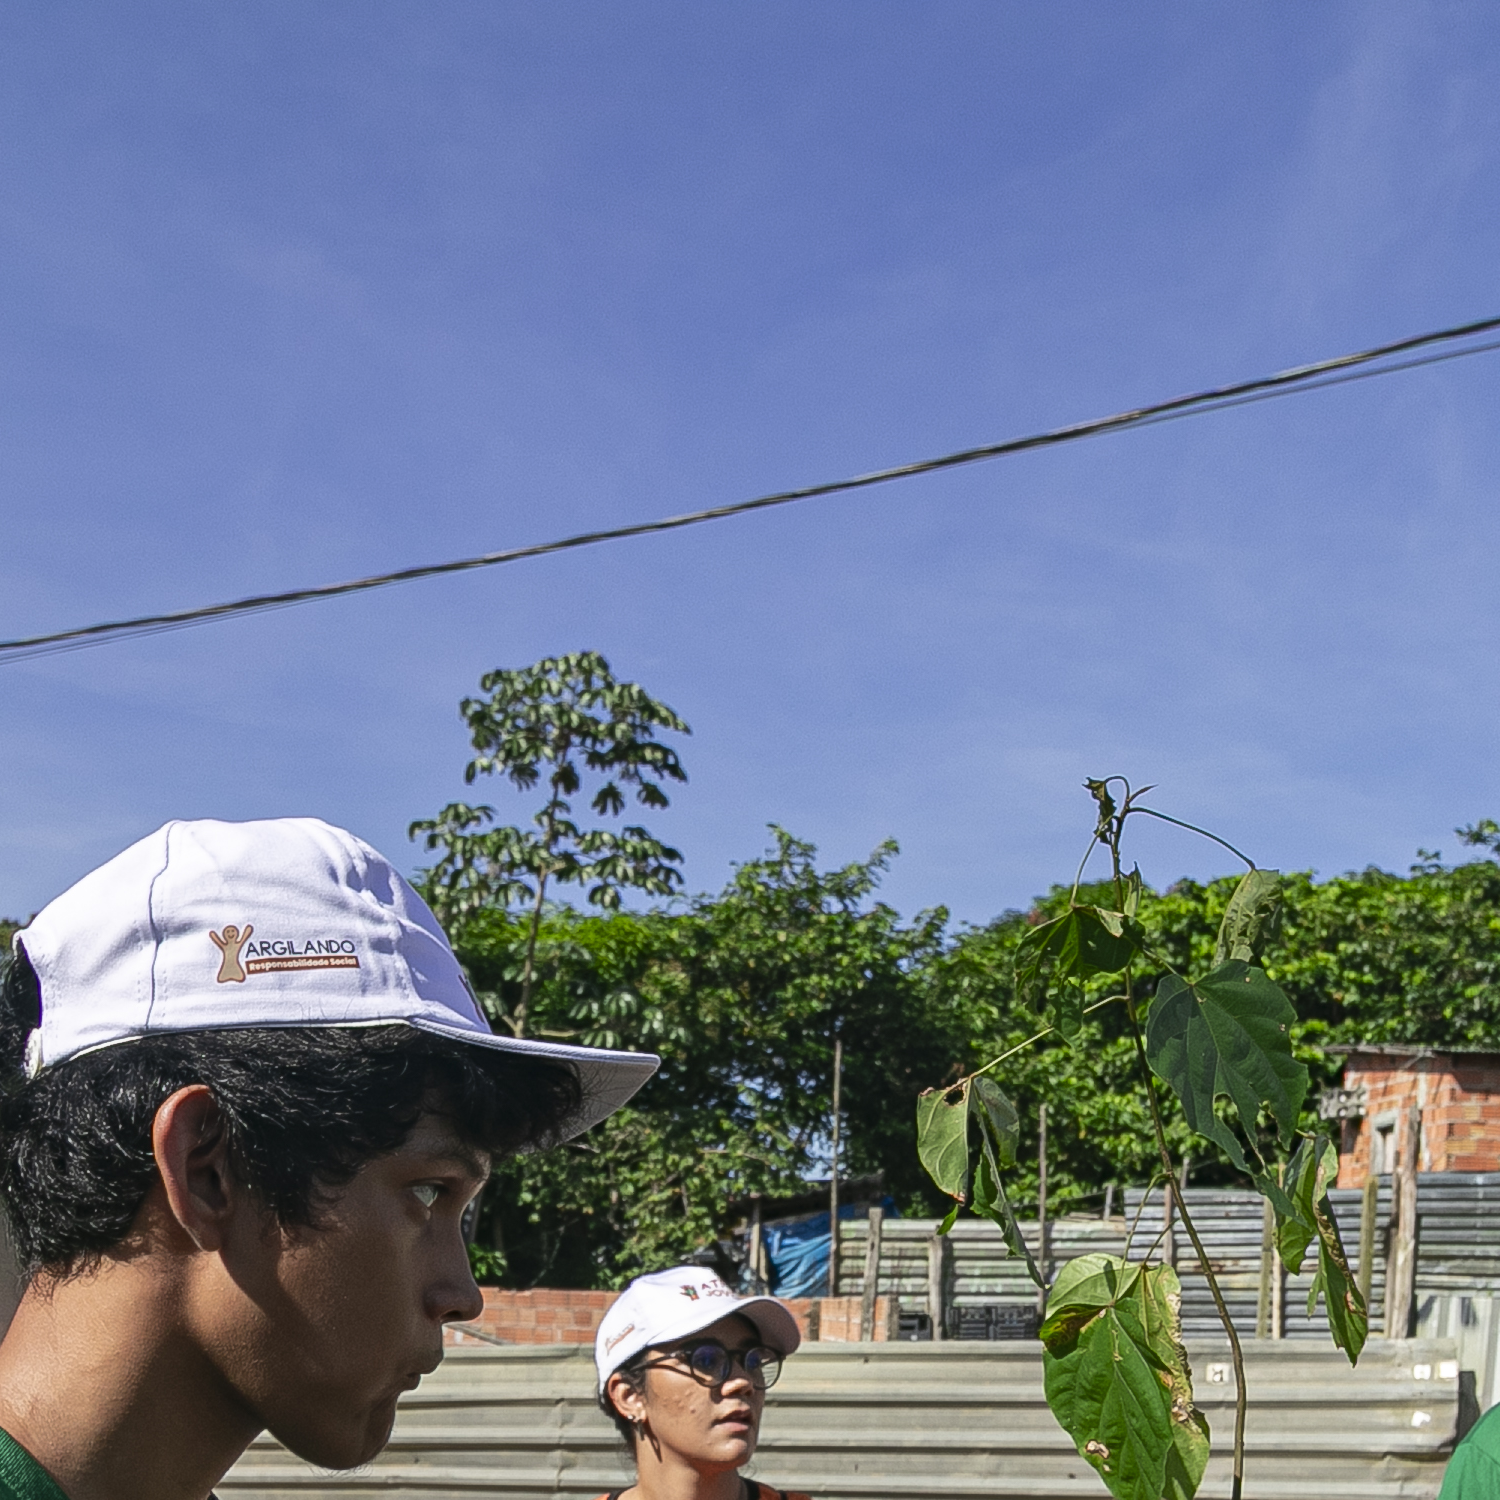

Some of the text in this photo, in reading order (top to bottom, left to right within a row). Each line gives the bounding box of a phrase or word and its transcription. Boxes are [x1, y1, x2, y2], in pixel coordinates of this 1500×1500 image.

[245, 940, 355, 958] ARGILANDO
[249, 957, 357, 971] Responsabilidade Social
